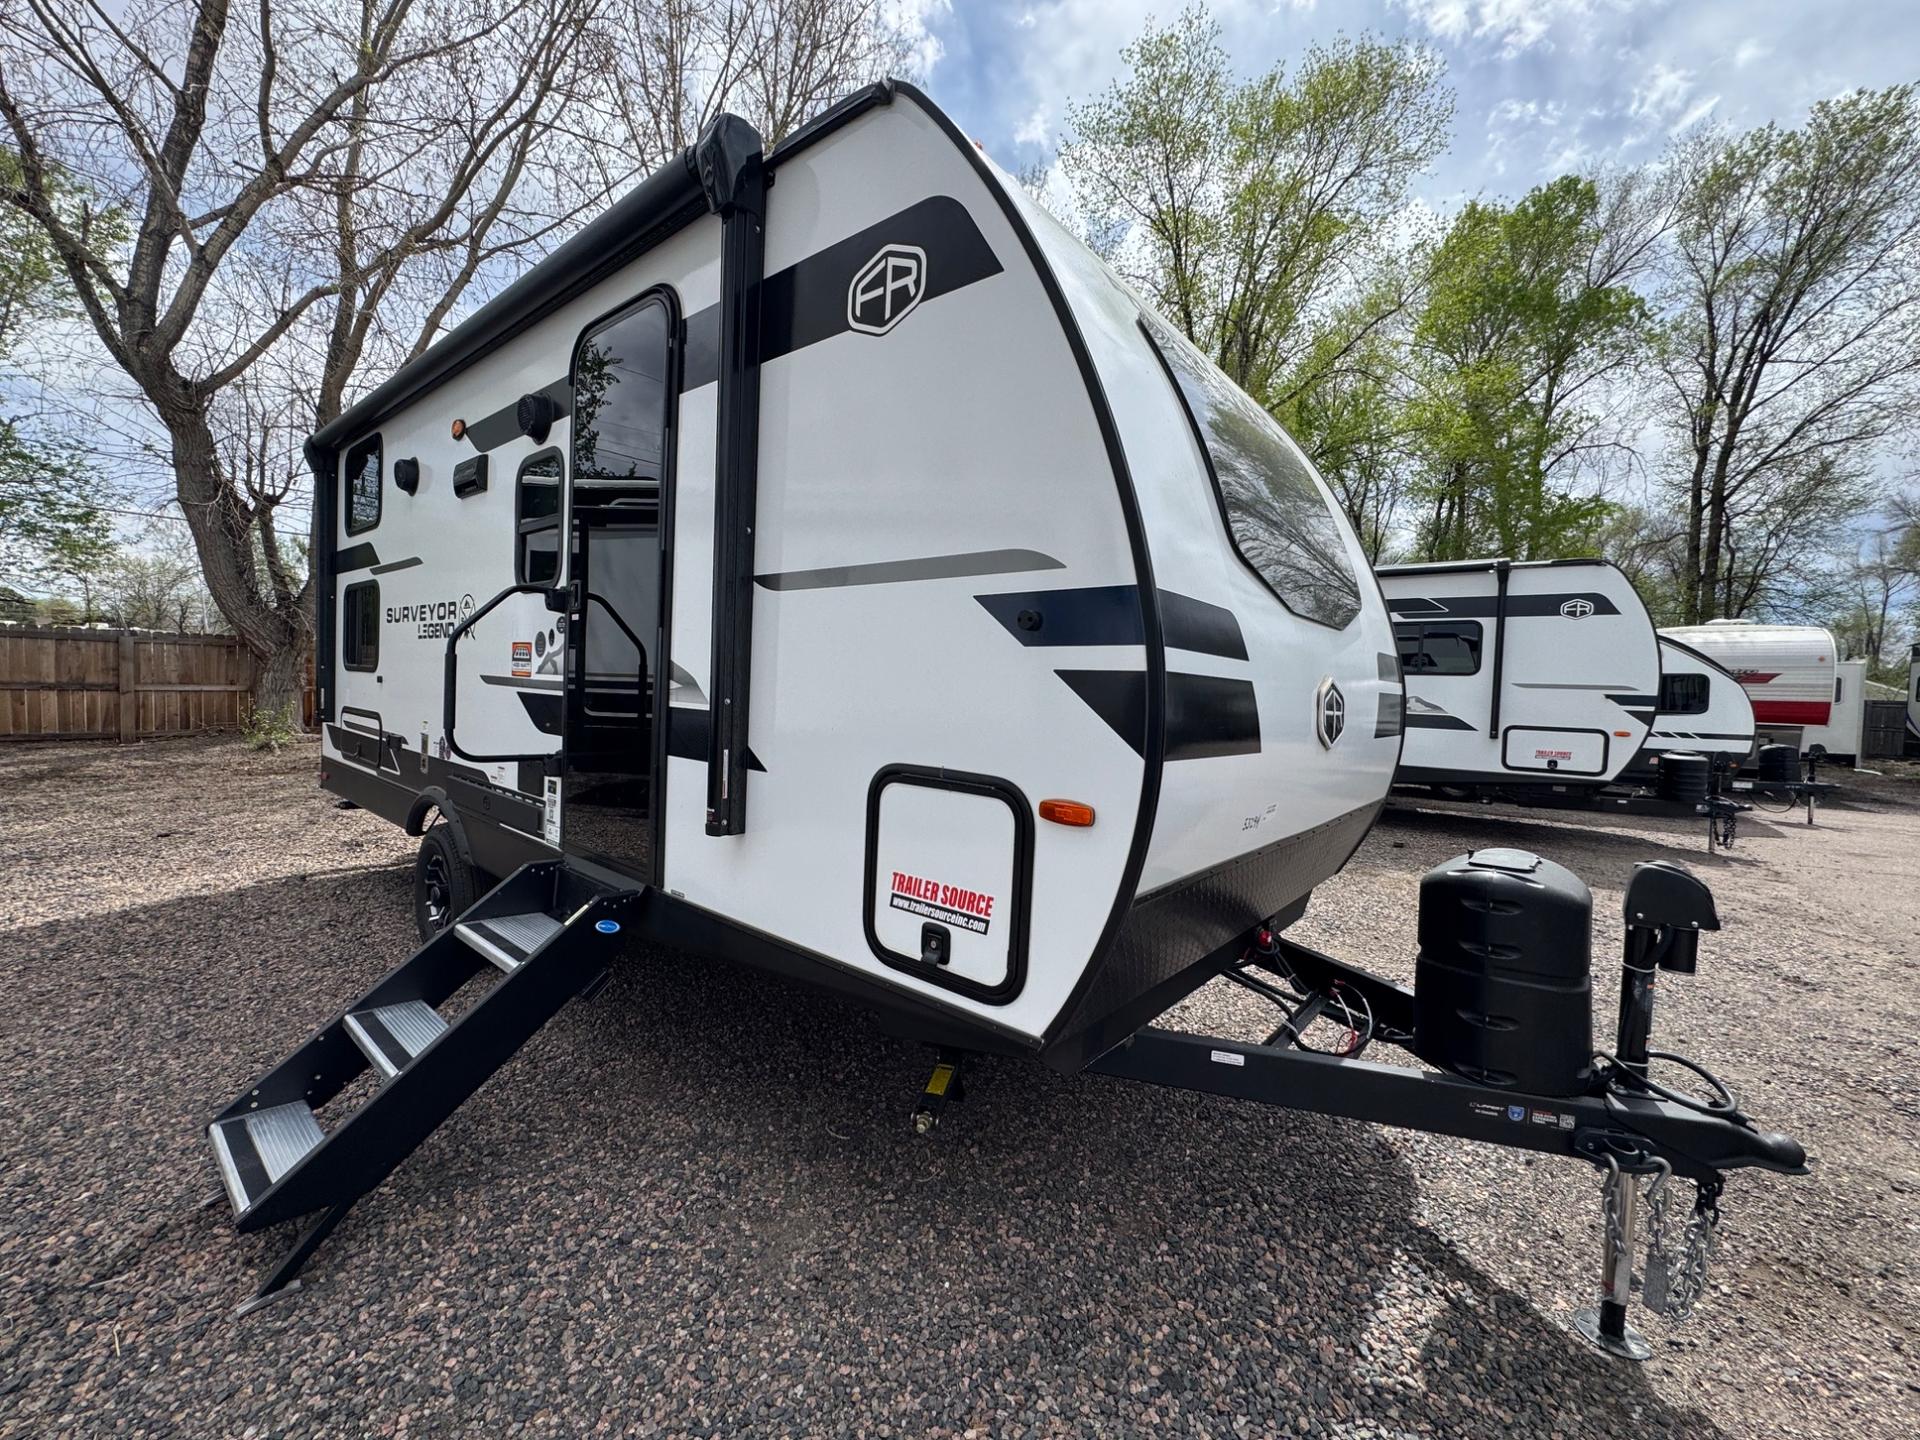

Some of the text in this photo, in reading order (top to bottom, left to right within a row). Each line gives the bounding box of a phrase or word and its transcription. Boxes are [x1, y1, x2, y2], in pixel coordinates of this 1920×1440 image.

[386, 601, 457, 624] SURVEYOR
[417, 621, 455, 640] LEGEND
[891, 871, 994, 918] TRAILER SOURCE
[891, 896, 987, 933] www.trailersourceinc.com
